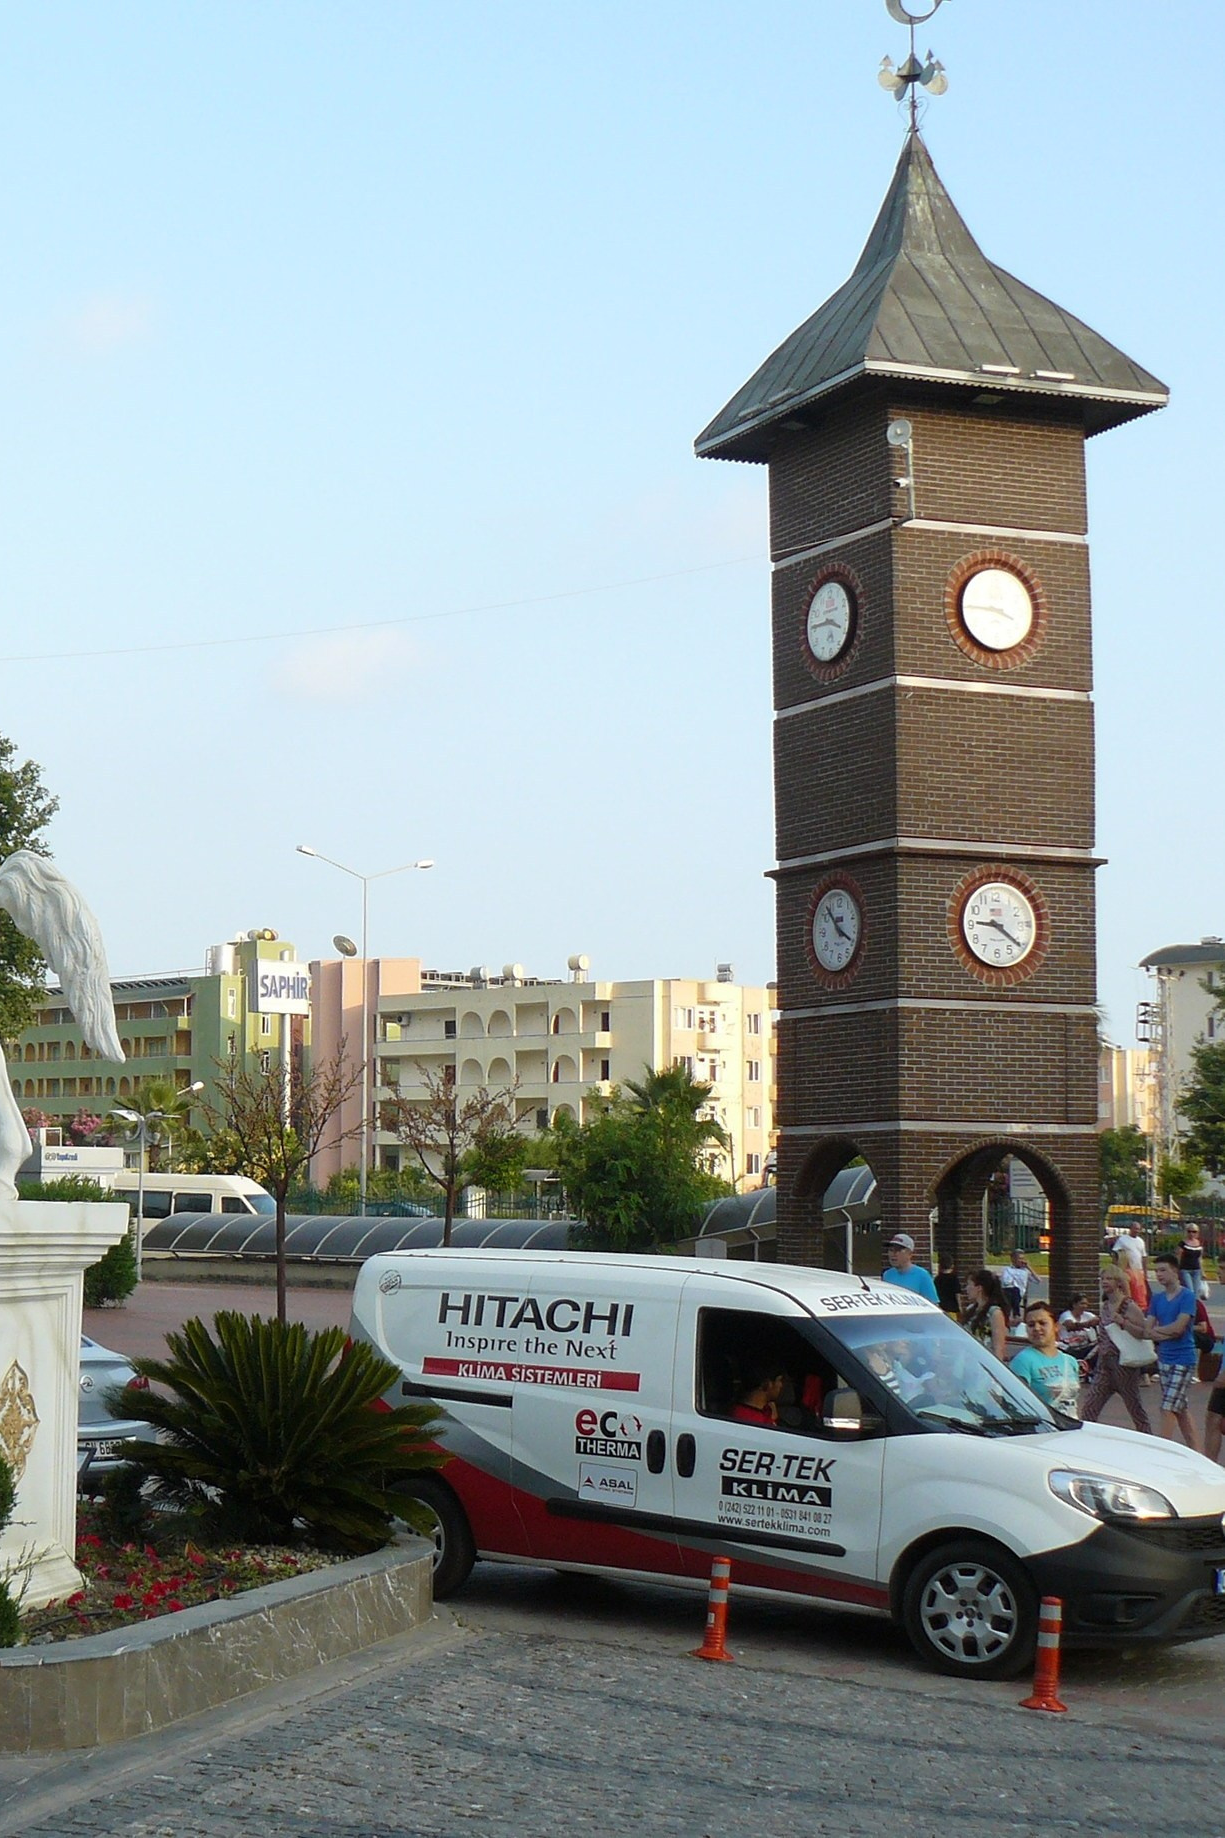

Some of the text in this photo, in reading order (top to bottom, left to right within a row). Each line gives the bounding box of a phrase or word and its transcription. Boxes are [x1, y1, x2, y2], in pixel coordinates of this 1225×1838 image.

[819, 1293, 890, 1312] SER-TEK
[438, 1292, 635, 1337] HITACHI
[446, 1331, 618, 1360] Inspire the Next
[458, 1361, 602, 1388] KLİMA SİSTEMLERİ
[578, 1438, 639, 1458] THERMA
[719, 1448, 837, 1482] SER-TEK
[599, 1478, 634, 1490] ASAL
[732, 1482, 822, 1505] KLİMA
[725, 1501, 742, 1515] (242)
[743, 1503, 756, 1515] 522
[757, 1505, 765, 1516] 11
[766, 1506, 774, 1517] 01
[717, 1515, 831, 1537] www.sertekklima.com
